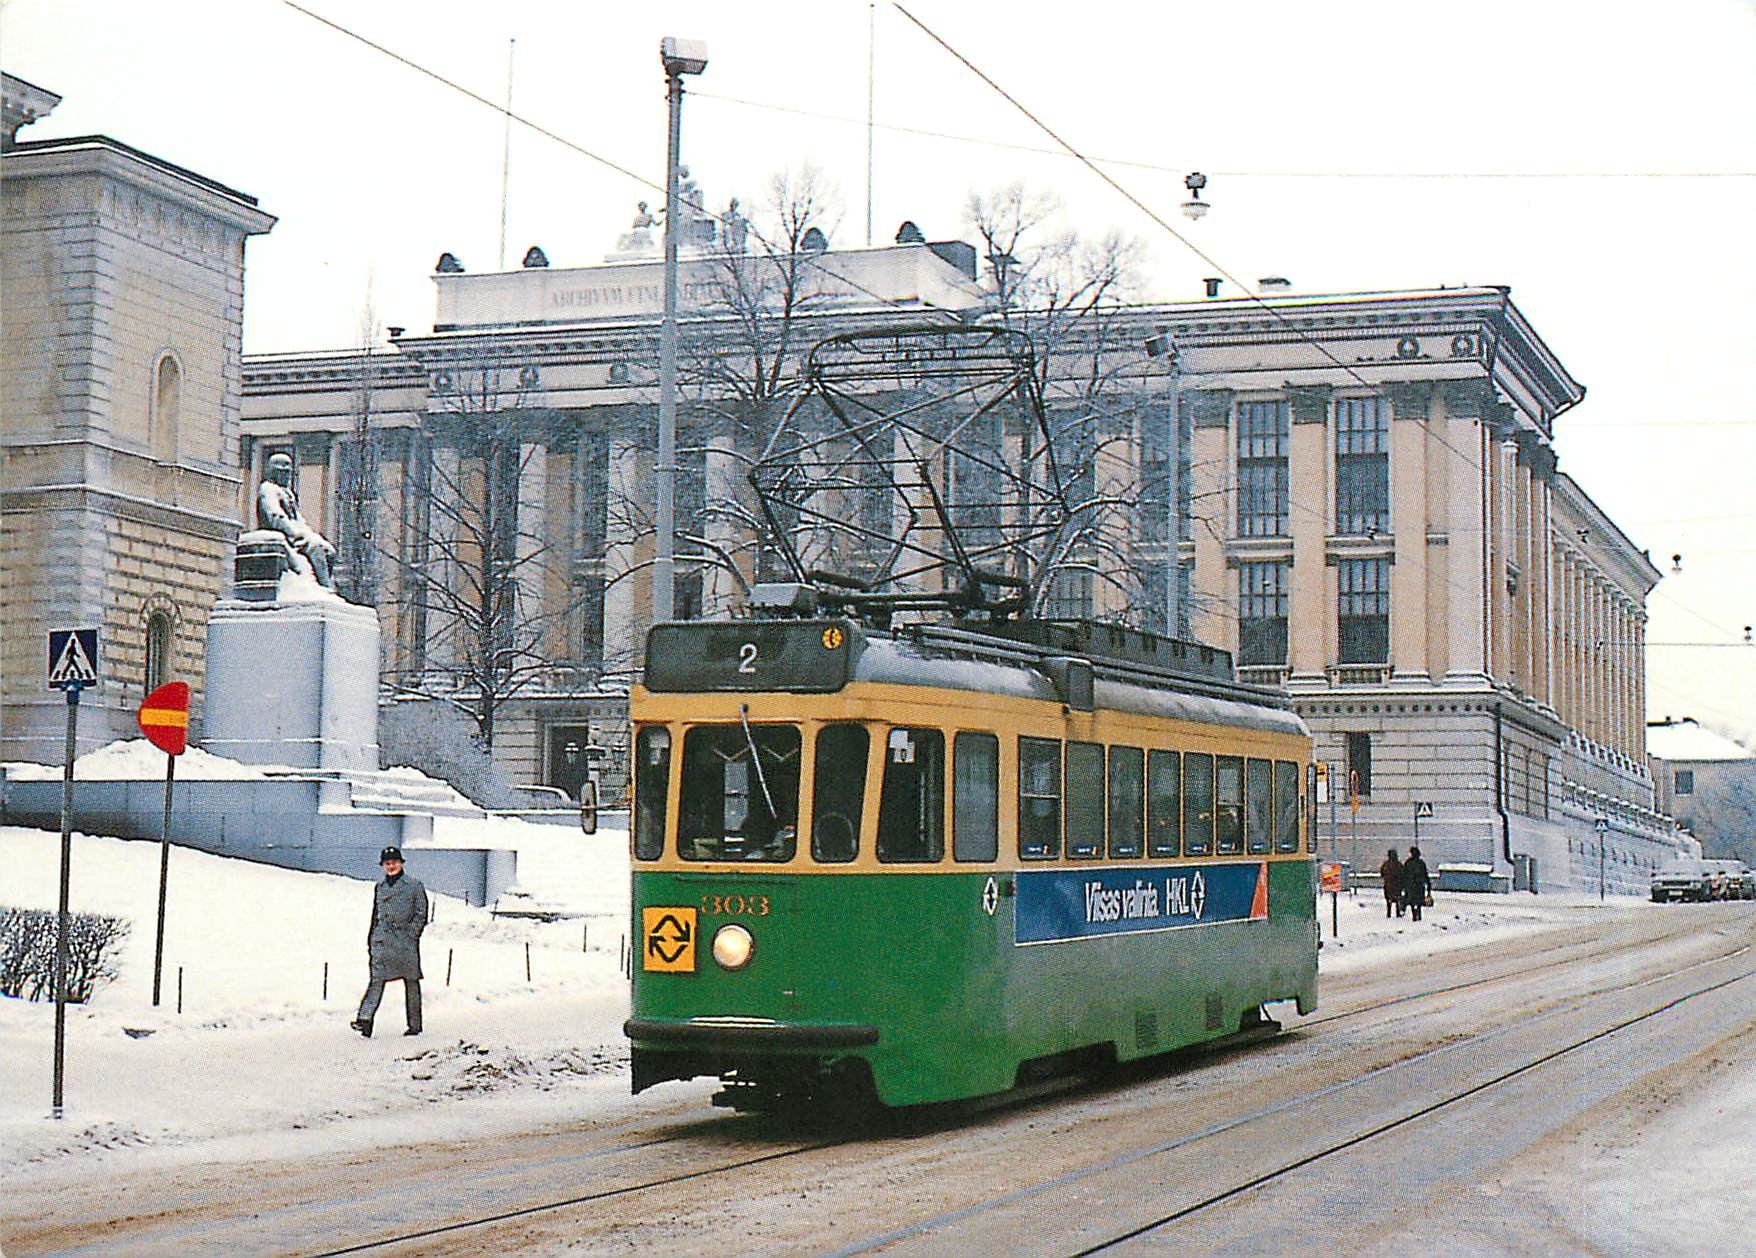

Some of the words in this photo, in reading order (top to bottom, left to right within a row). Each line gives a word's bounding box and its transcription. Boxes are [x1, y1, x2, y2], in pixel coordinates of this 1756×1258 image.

[739, 643, 757, 672] 2
[1085, 882, 1120, 922] Viisas
[1166, 877, 1190, 915] HKL
